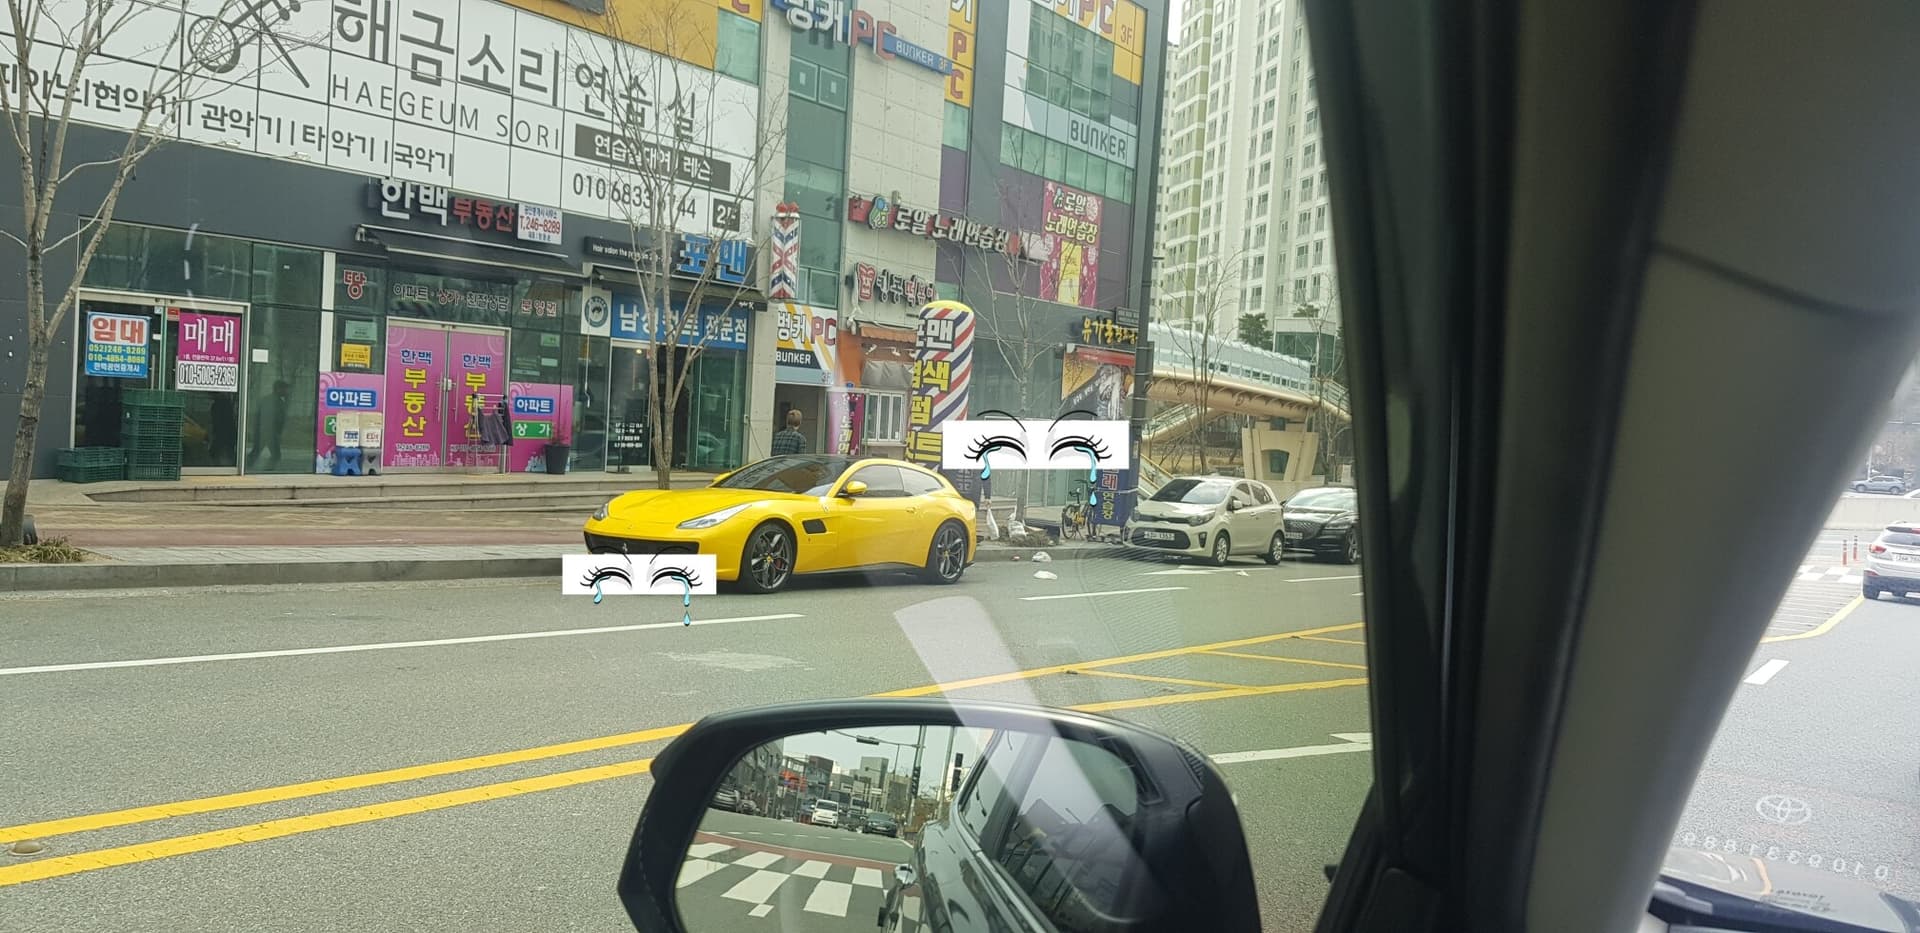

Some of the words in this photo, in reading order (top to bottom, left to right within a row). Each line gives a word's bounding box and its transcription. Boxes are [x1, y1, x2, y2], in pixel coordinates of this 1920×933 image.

[1120, 25, 1133, 46] 3F
[332, 0, 560, 107] 해금소리
[895, 40, 935, 66] BUNKER
[332, 73, 479, 131] HAEGEUM
[496, 113, 559, 150] SORI
[1070, 120, 1126, 160] BUNKER
[572, 172, 607, 201] 010
[381, 177, 448, 227] 한백
[453, 196, 514, 232] 부동산
[932, 213, 1010, 253] 노래연습장
[1045, 211, 1098, 244] 노래연습장
[343, 269, 367, 300] 땅
[393, 283, 429, 301] 아파트
[93, 317, 145, 345] 임대
[183, 317, 235, 355] 매매
[704, 314, 748, 344] 전문점
[400, 349, 432, 365] 한백
[463, 353, 492, 369] 한백
[776, 350, 811, 365] BUNKER
[329, 390, 373, 408] 아파트
[516, 397, 553, 412] 아파트
